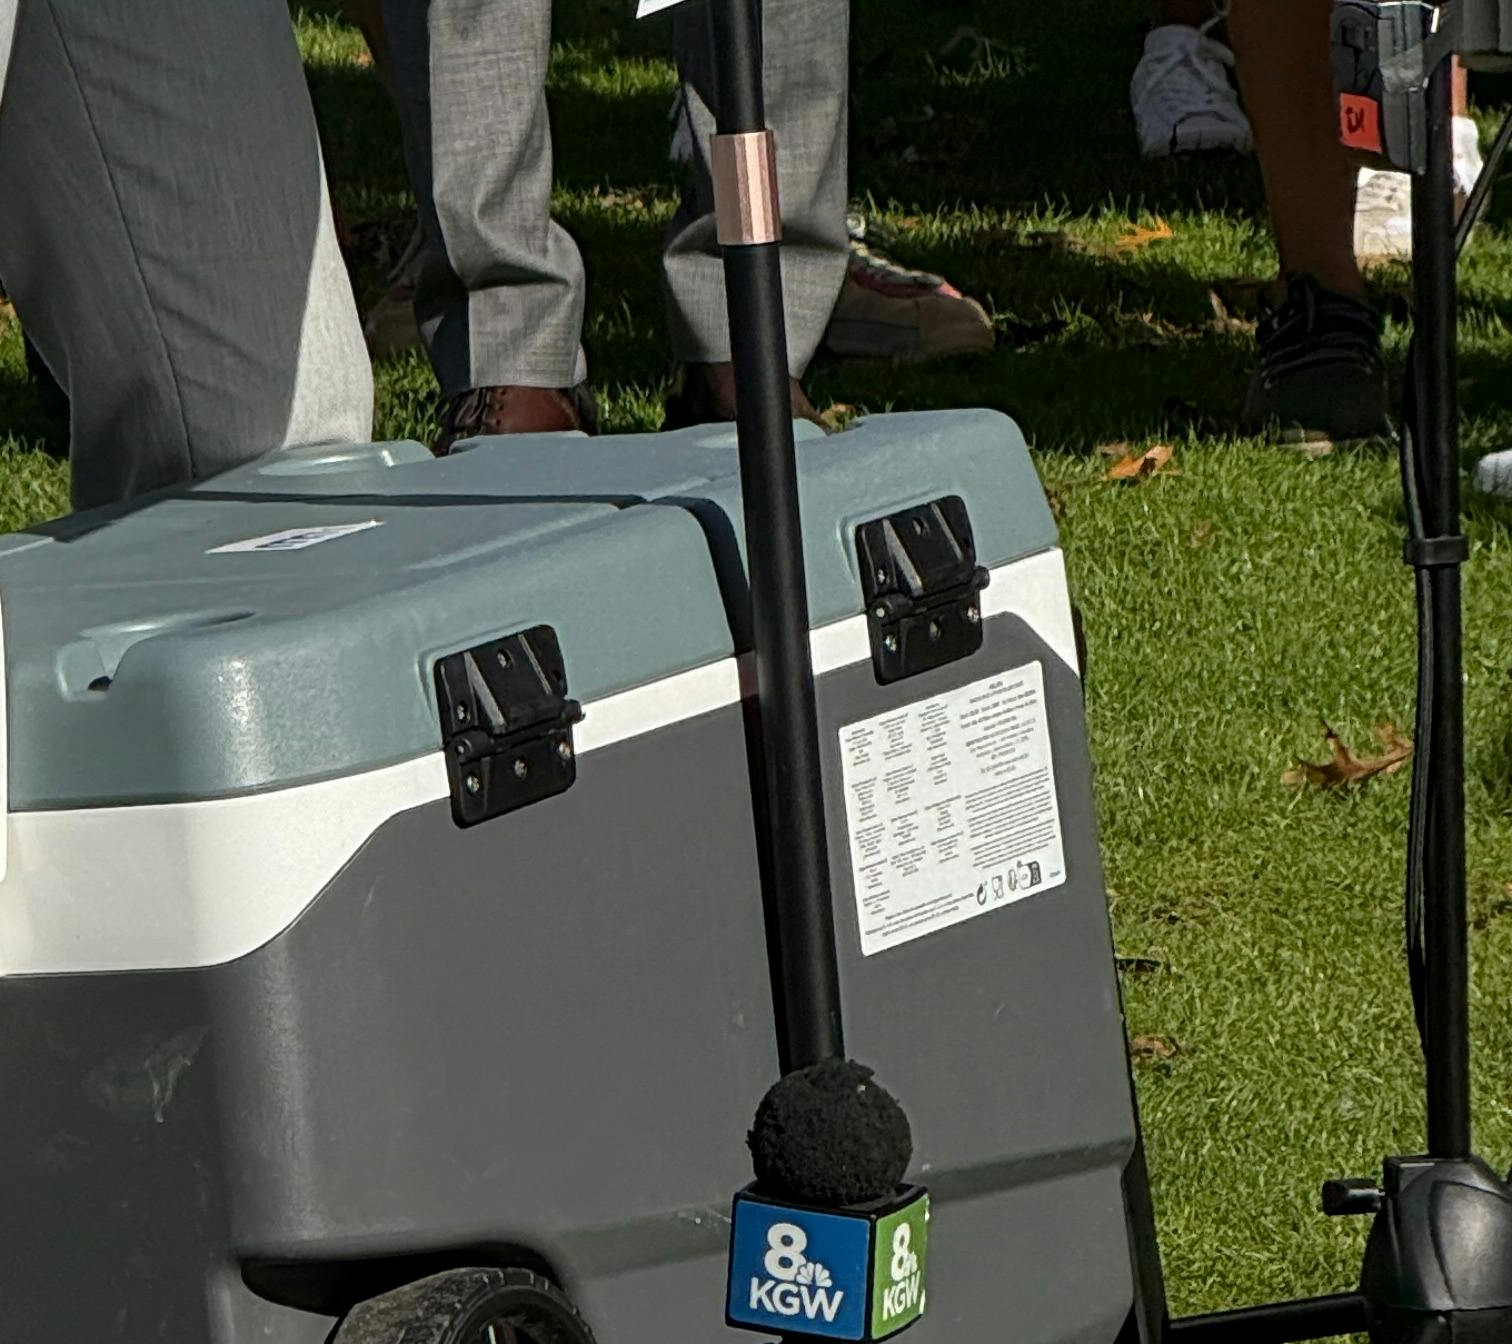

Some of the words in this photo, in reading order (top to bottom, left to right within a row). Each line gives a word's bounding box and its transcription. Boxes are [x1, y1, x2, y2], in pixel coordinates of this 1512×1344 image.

[764, 1222, 808, 1282] 8
[890, 1221, 911, 1282] 8
[748, 1275, 845, 1323] KGW
[881, 1270, 921, 1322] KGW
